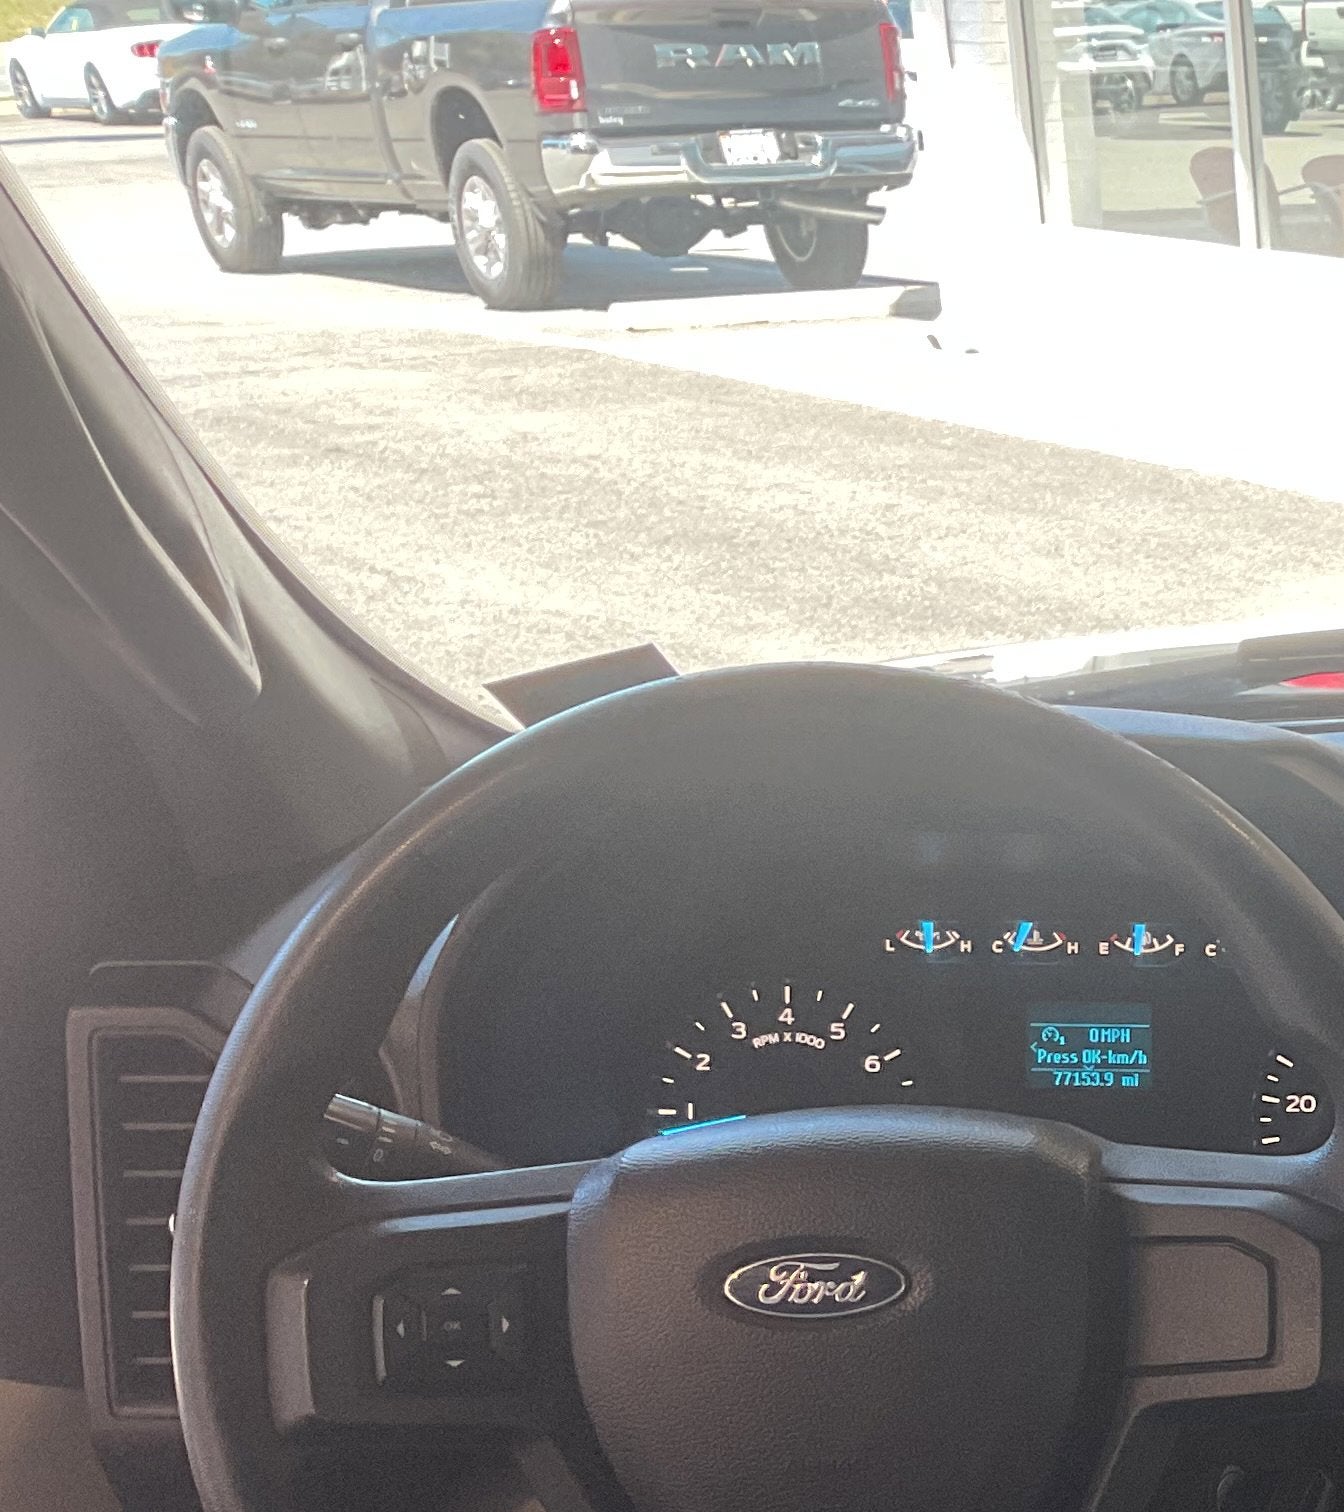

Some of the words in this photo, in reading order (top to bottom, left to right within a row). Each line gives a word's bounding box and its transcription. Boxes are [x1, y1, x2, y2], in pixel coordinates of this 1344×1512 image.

[654, 41, 821, 68] RAM
[885, 939, 896, 952] L
[960, 940, 972, 953] H
[992, 941, 1003, 954] C
[1067, 942, 1079, 955] H
[1099, 942, 1110, 955] E
[1175, 943, 1185, 957] F
[1205, 944, 1216, 957] C
[779, 1008, 795, 1025] 4
[732, 1023, 747, 1040] 3
[829, 1023, 846, 1040] 5
[1101, 1028, 1131, 1043] MPH
[752, 1033, 780, 1049] RPM
[795, 1032, 826, 1050] 1000
[696, 1054, 711, 1071] 2
[864, 1055, 881, 1073] 6
[1037, 1049, 1079, 1064] Press
[1082, 1049, 1147, 1065] OK-km/h
[1053, 1071, 1114, 1087] 77153.9
[1121, 1073, 1139, 1087] mi
[688, 1102, 693, 1120] 1
[1286, 1095, 1317, 1113] 20
[758, 1260, 868, 1305] Ford
